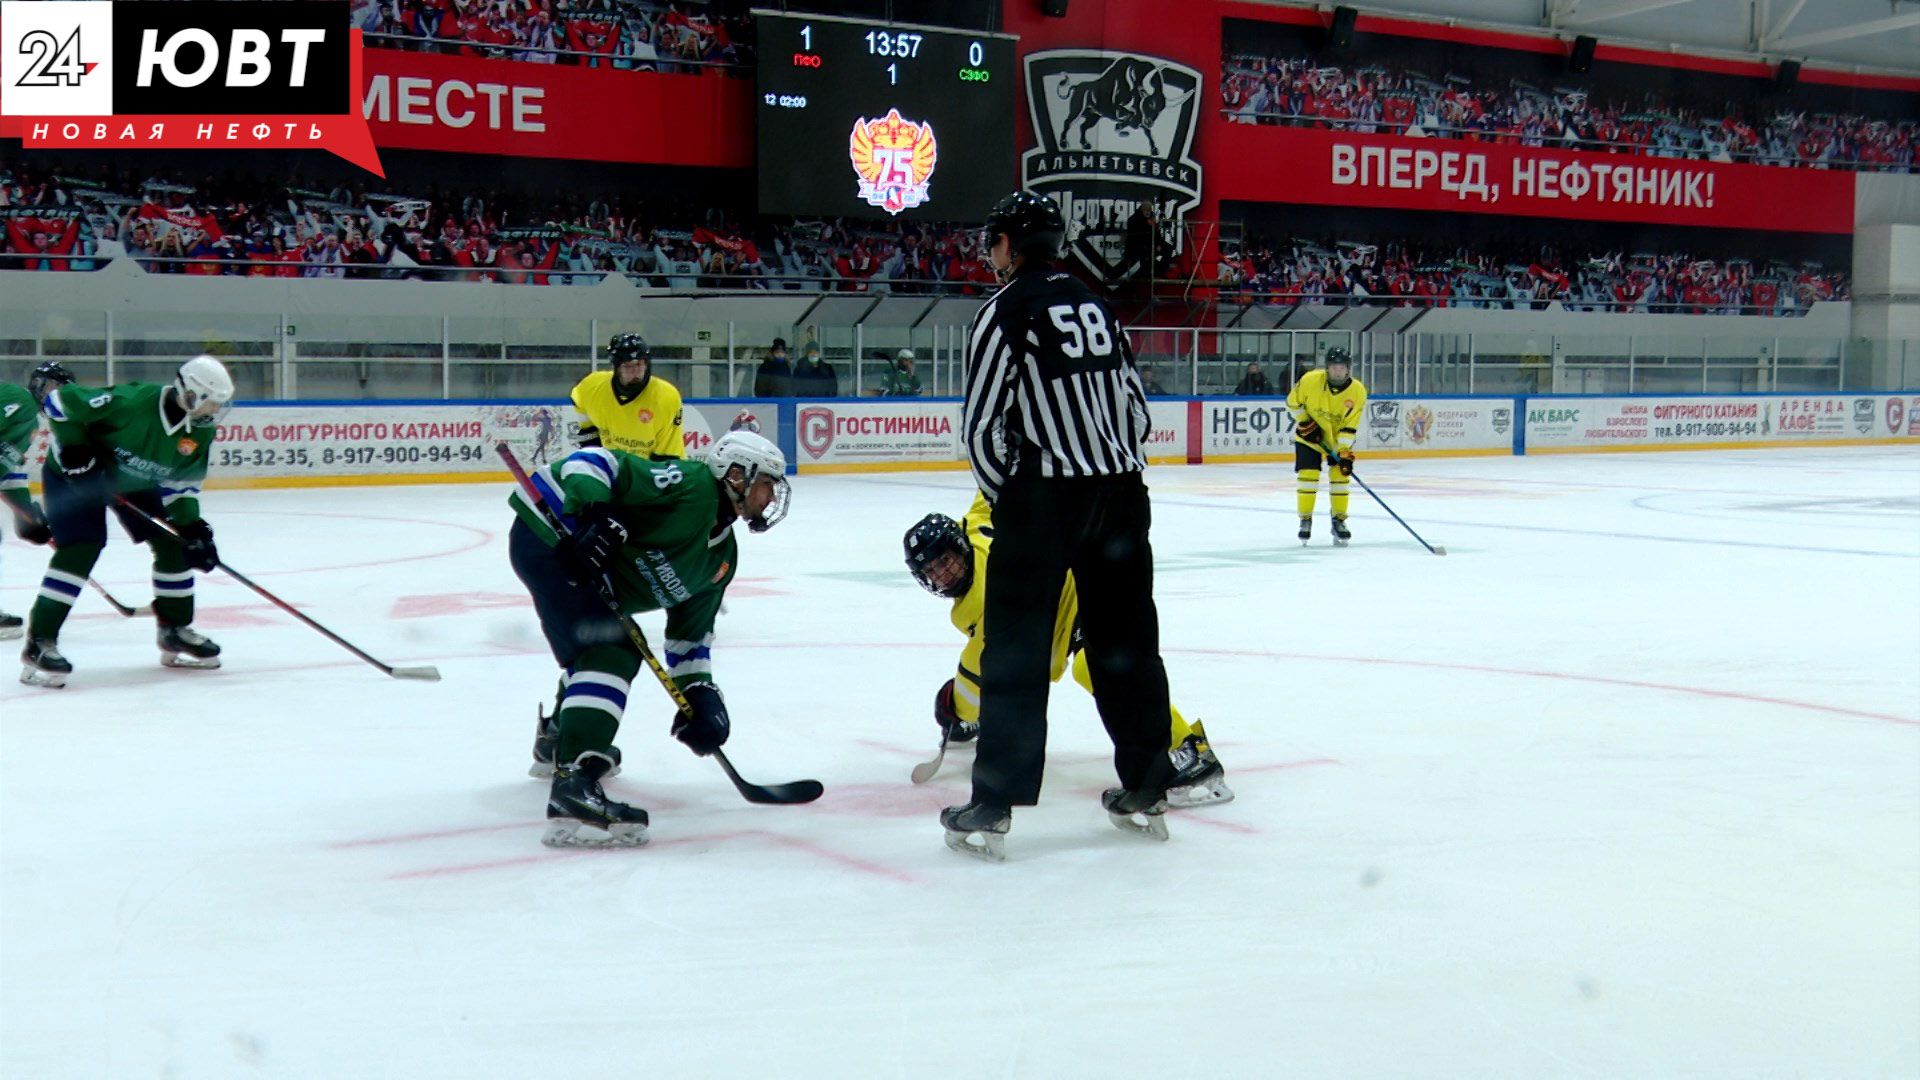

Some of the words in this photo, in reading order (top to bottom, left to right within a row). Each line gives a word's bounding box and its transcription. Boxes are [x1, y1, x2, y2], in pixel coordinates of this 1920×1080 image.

[800, 25, 811, 51] 1
[865, 31, 923, 58] 13:57
[968, 42, 983, 67] 0
[887, 63, 897, 85] 1
[363, 75, 546, 132] МЕСТЕ
[764, 93, 776, 106] 12
[780, 95, 807, 108] 02:00
[873, 149, 914, 191] 75
[1037, 155, 1189, 182] АЛЬМЕТЬЕВСК
[1331, 143, 1499, 203] ВПЕРЕД,
[1512, 157, 1715, 208] НЕФТЯНИК!
[1048, 303, 1112, 358] 58
[1528, 409, 1546, 423] АК
[1547, 409, 1580, 422] БАРС
[1654, 404, 1712, 419] ФИГУРНОГО
[1714, 404, 1757, 418] КАТАНИЯ
[1780, 401, 1844, 414] АРЕНДА
[262, 422, 388, 442] ФИГУРНОГО
[392, 421, 482, 439] КАТАНИЯ
[836, 416, 951, 437] ГОСТИНИЦА
[1676, 421, 1756, 436] 8-917-900-94-94
[1779, 415, 1816, 430] КАФЕ
[220, 449, 314, 468] 35-32-35,
[322, 445, 482, 464] 8-917-900-94-94
